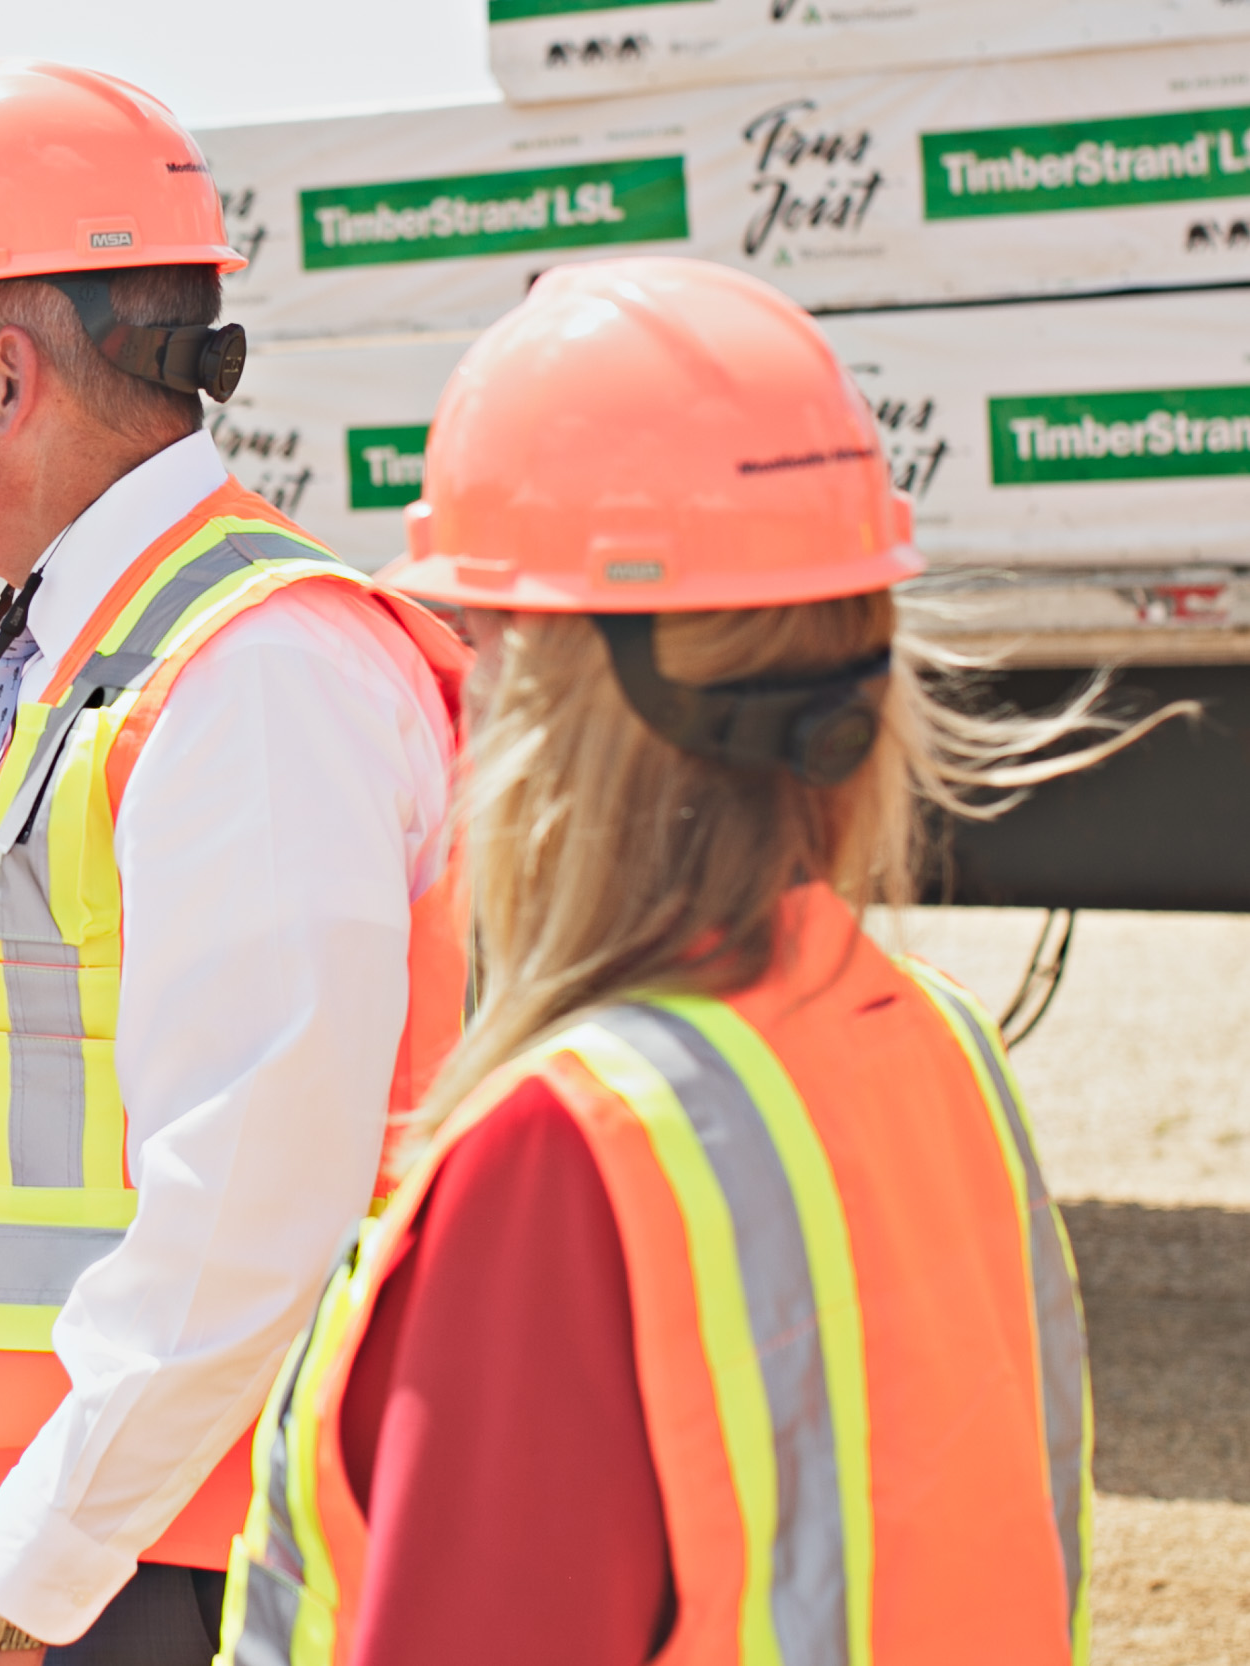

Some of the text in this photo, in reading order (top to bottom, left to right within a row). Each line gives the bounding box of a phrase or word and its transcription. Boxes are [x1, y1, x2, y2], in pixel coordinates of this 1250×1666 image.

[743, 99, 870, 172] Trus
[940, 132, 1210, 195] TimberStrand
[91, 232, 132, 248] MSA
[315, 188, 549, 248] TimberStrand
[554, 181, 626, 226] LSL
[743, 170, 886, 259] Joist
